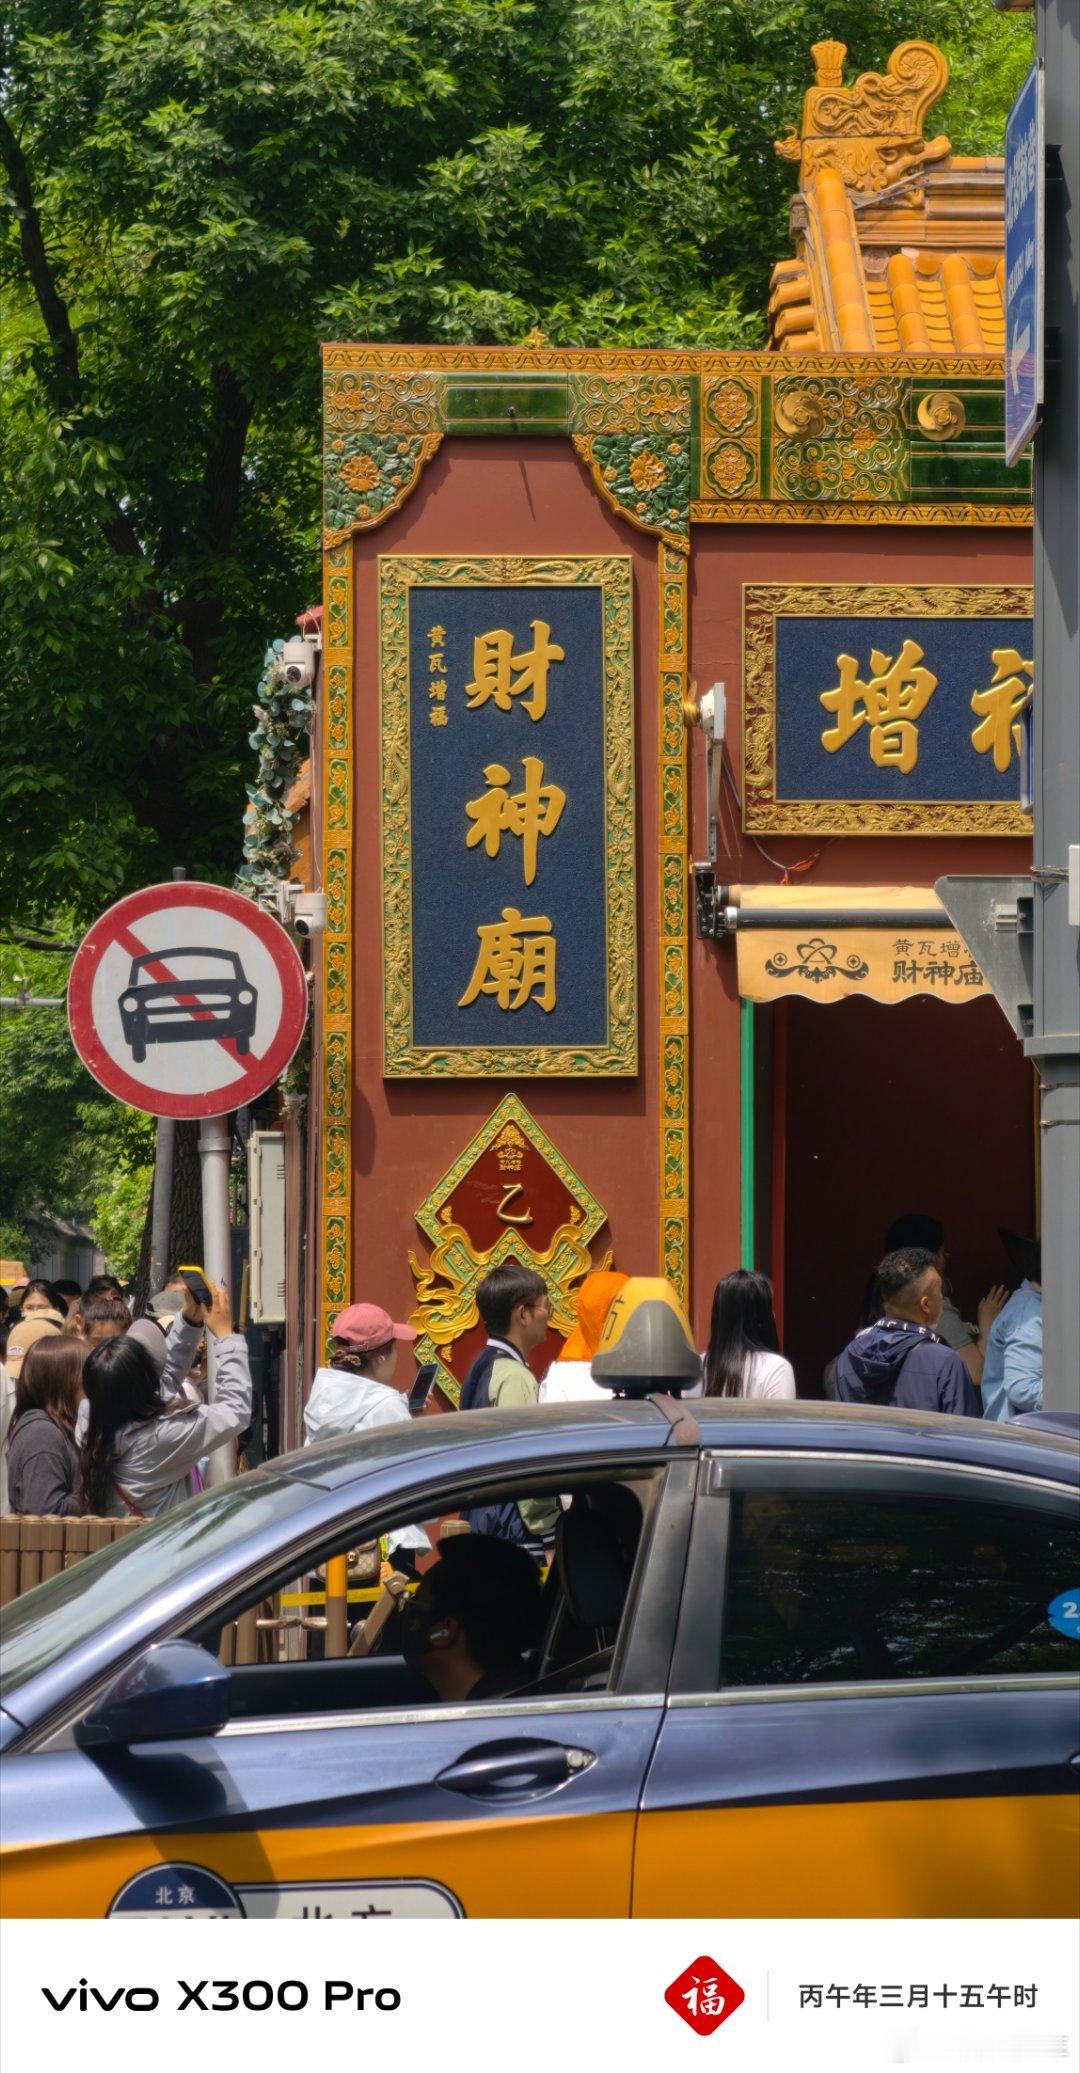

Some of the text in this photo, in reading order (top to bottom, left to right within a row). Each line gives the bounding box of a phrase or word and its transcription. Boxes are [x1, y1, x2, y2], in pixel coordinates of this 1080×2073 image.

[457, 619, 567, 1012] 財神廟
[892, 938, 972, 958] 黄瓦增
[891, 959, 984, 986] 财神庙
[1062, 1601, 1080, 1618] 2
[155, 1885, 195, 1906] 北京
